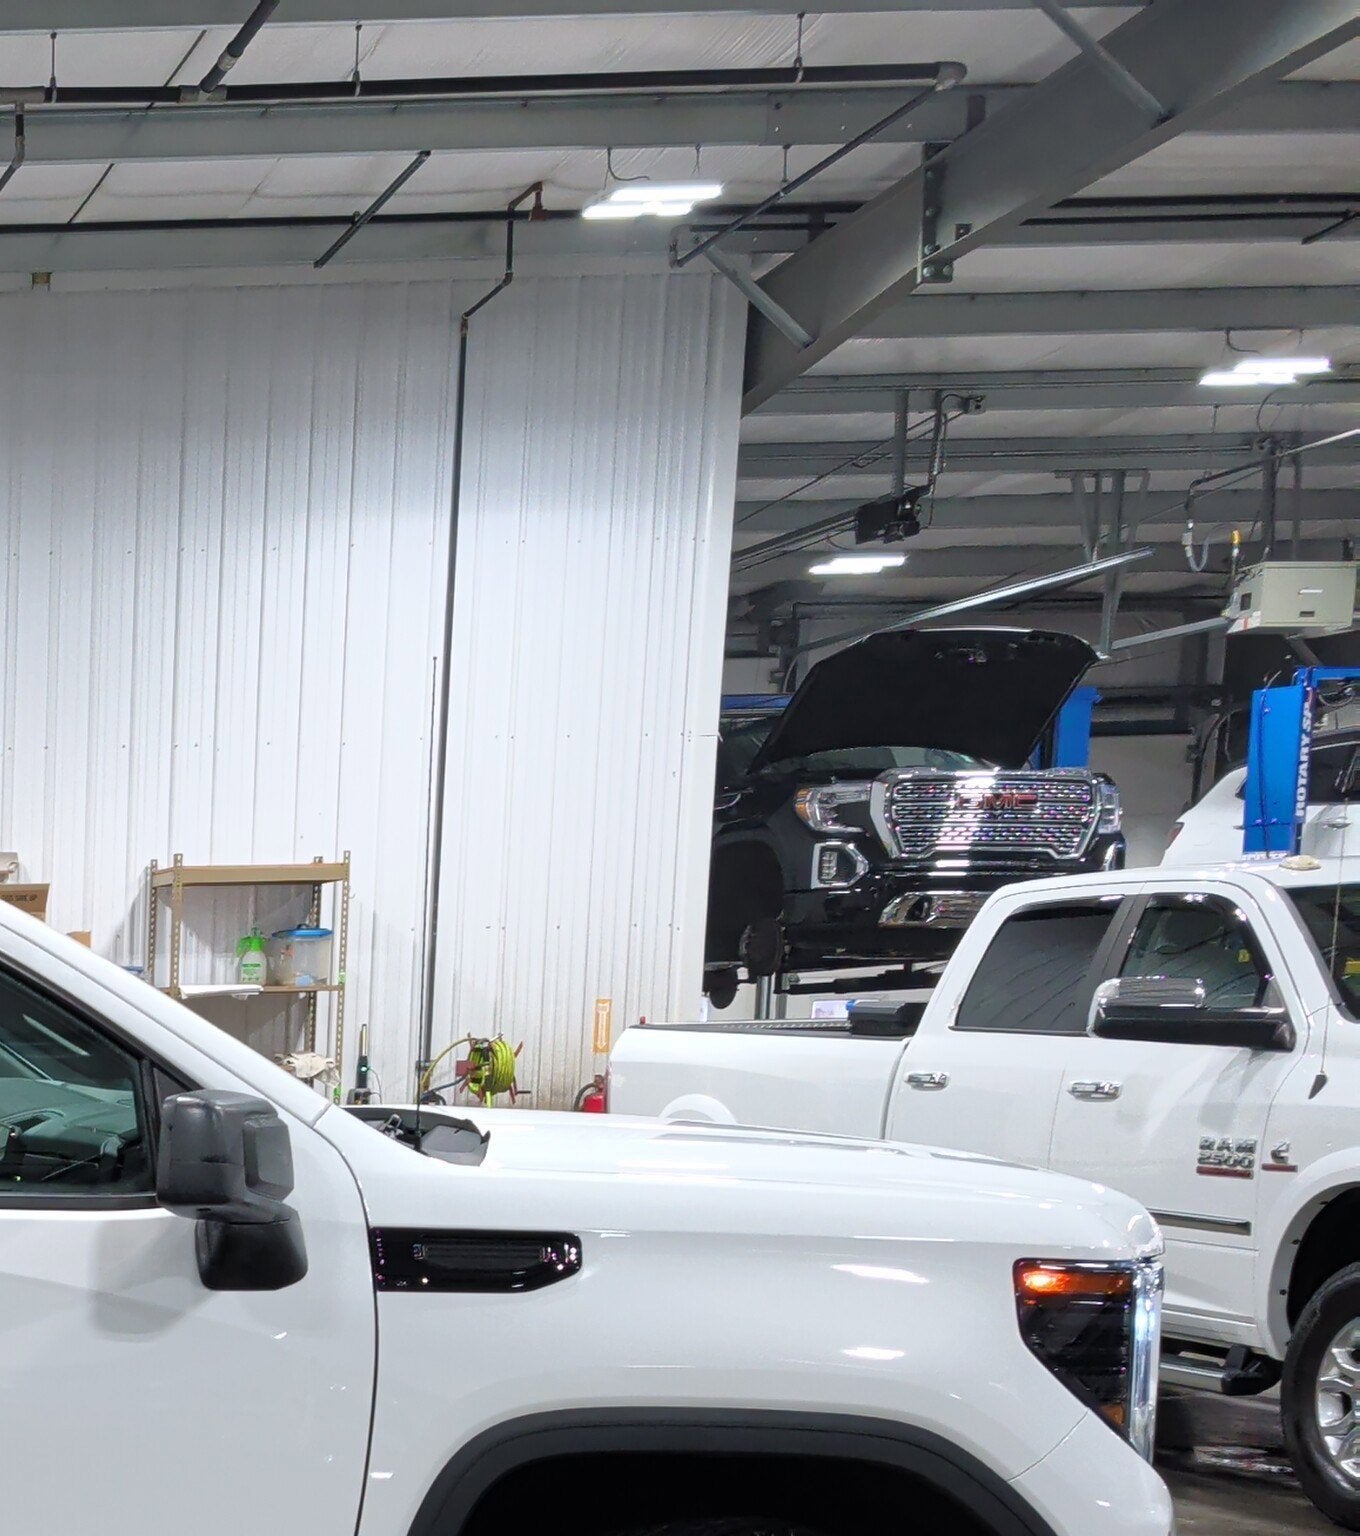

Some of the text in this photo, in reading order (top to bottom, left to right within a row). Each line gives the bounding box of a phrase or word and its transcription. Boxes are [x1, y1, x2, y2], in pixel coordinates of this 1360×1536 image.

[1295, 735, 1311, 817] ROTARY
[1199, 1135, 1258, 1154] RAM
[1197, 1152, 1256, 1169] 2500
